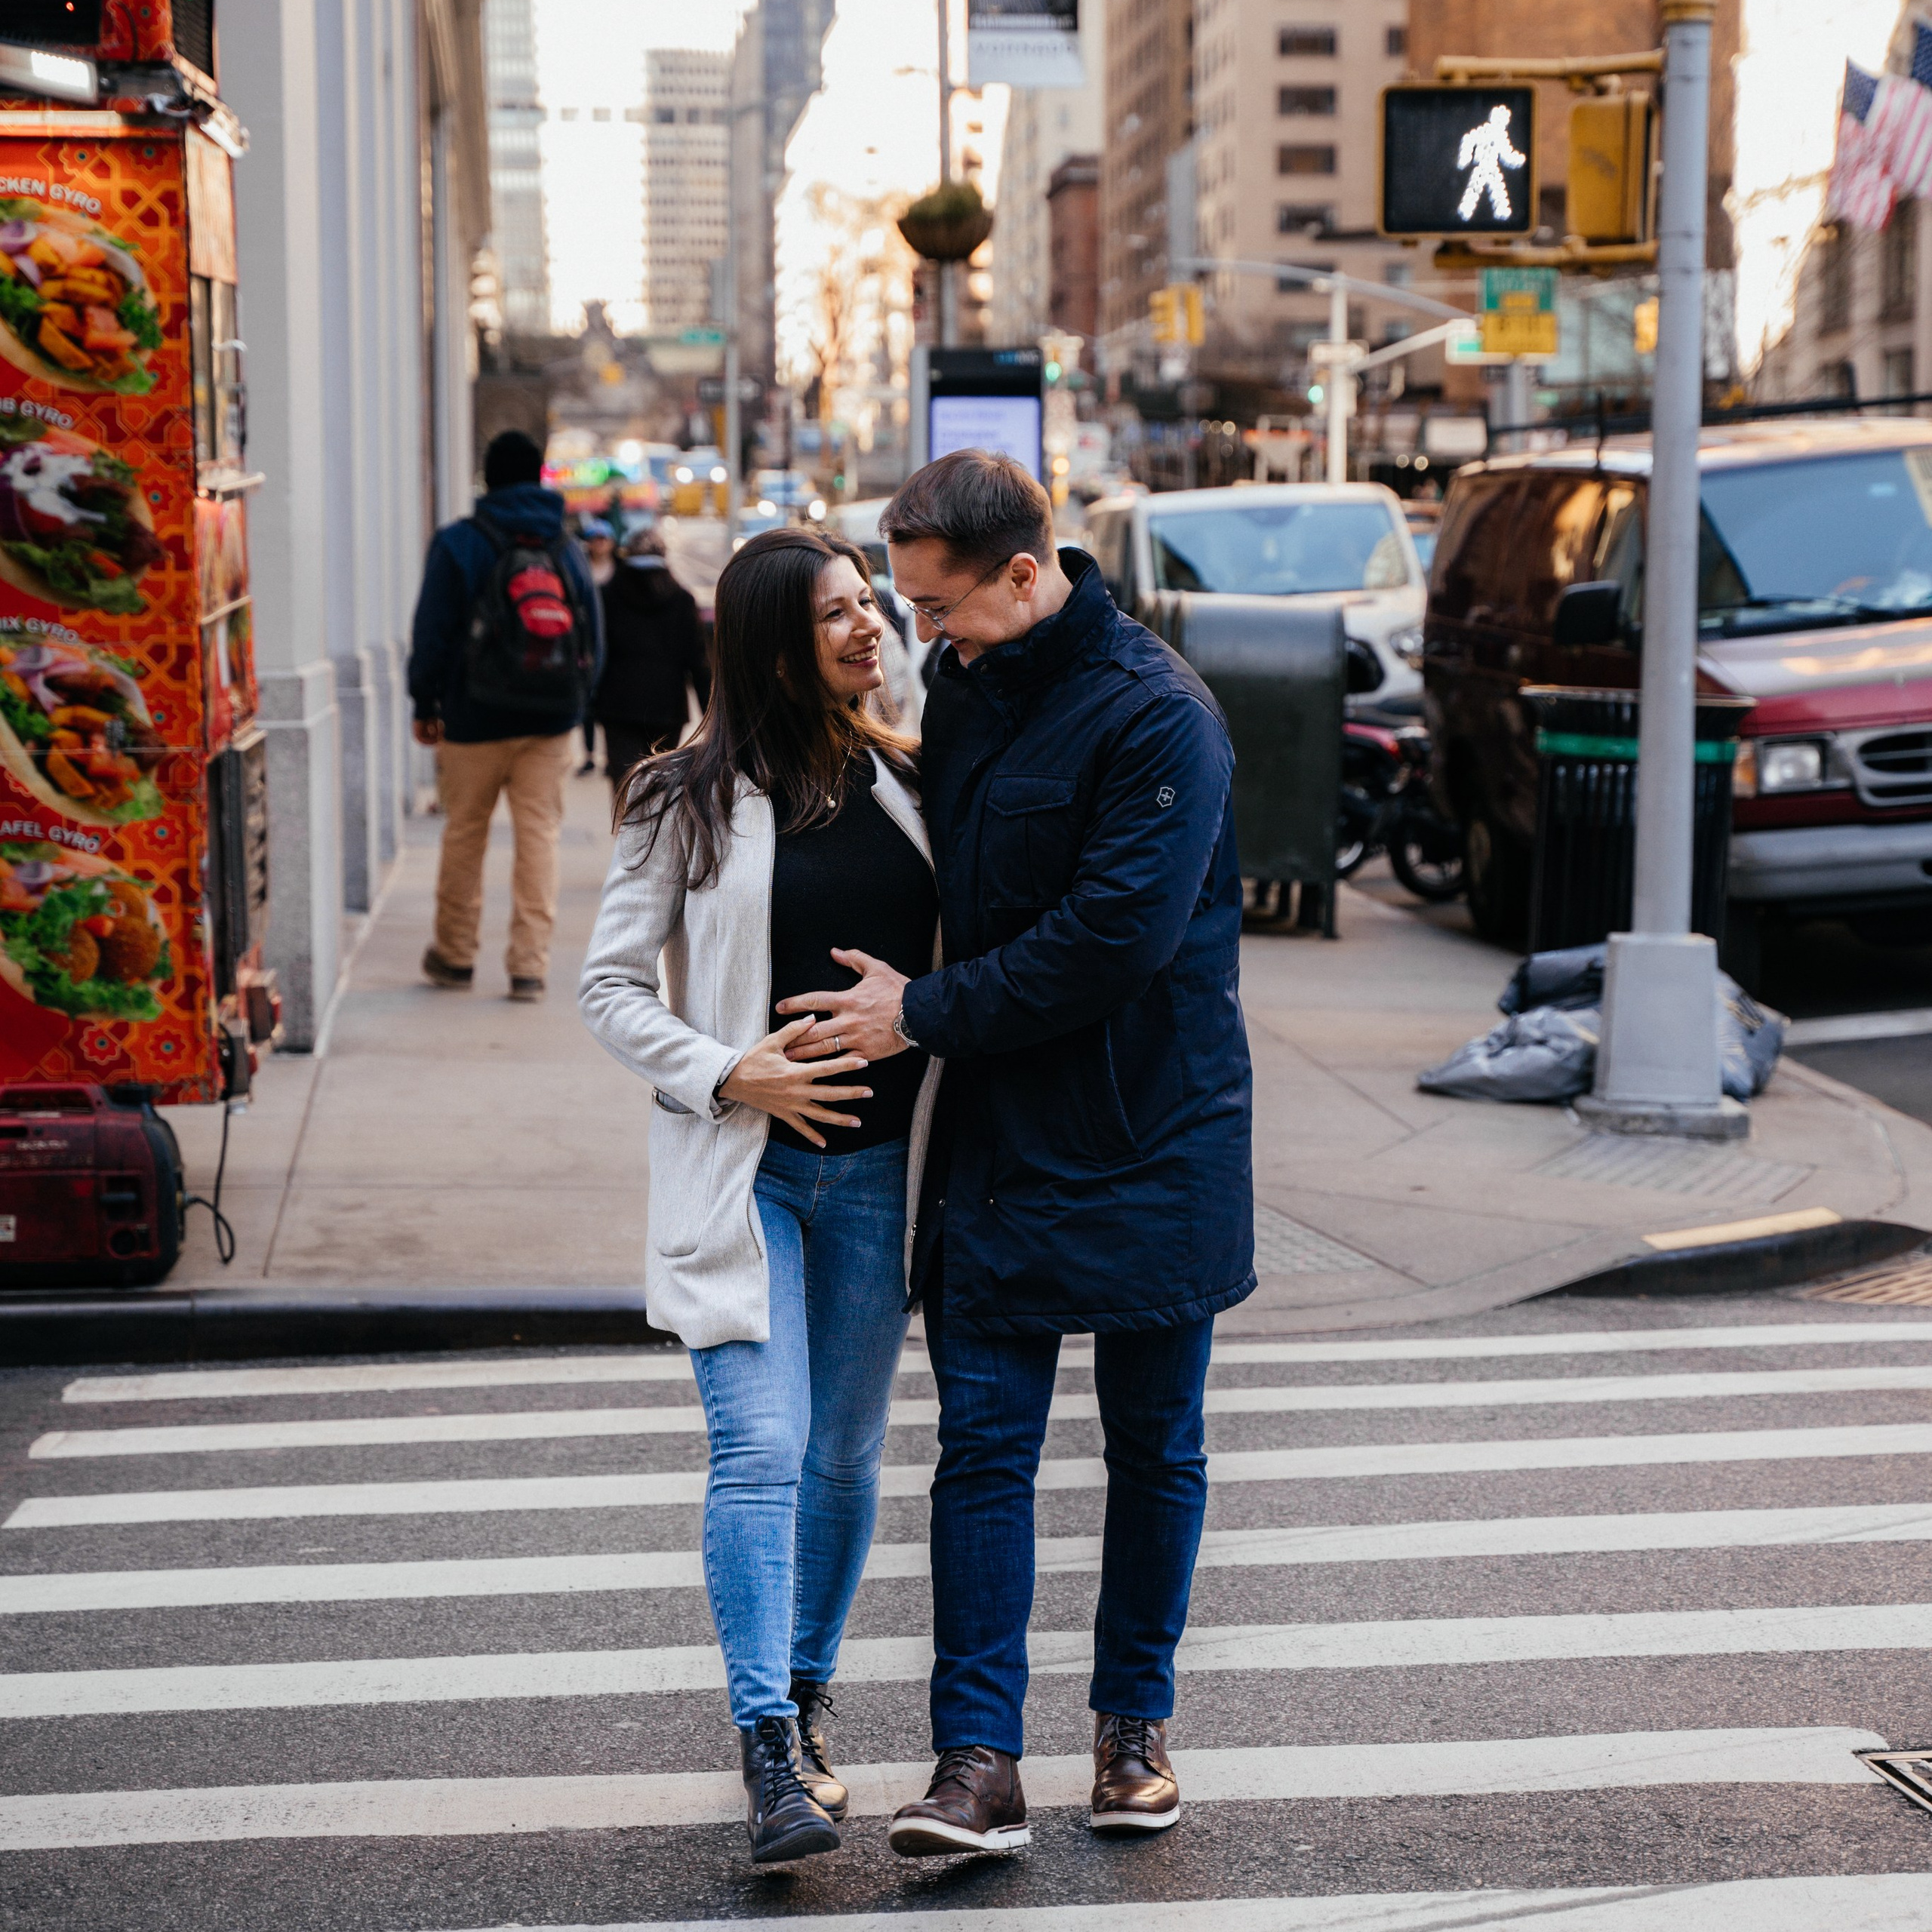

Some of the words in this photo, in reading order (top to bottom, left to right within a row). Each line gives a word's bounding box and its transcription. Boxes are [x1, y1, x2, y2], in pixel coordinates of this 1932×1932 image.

[50, 183, 101, 214] GYRO
[20, 399, 74, 430] GYRO
[26, 617, 79, 645] GYRO
[0, 820, 45, 838] AFEL
[48, 826, 100, 854] GYRO
